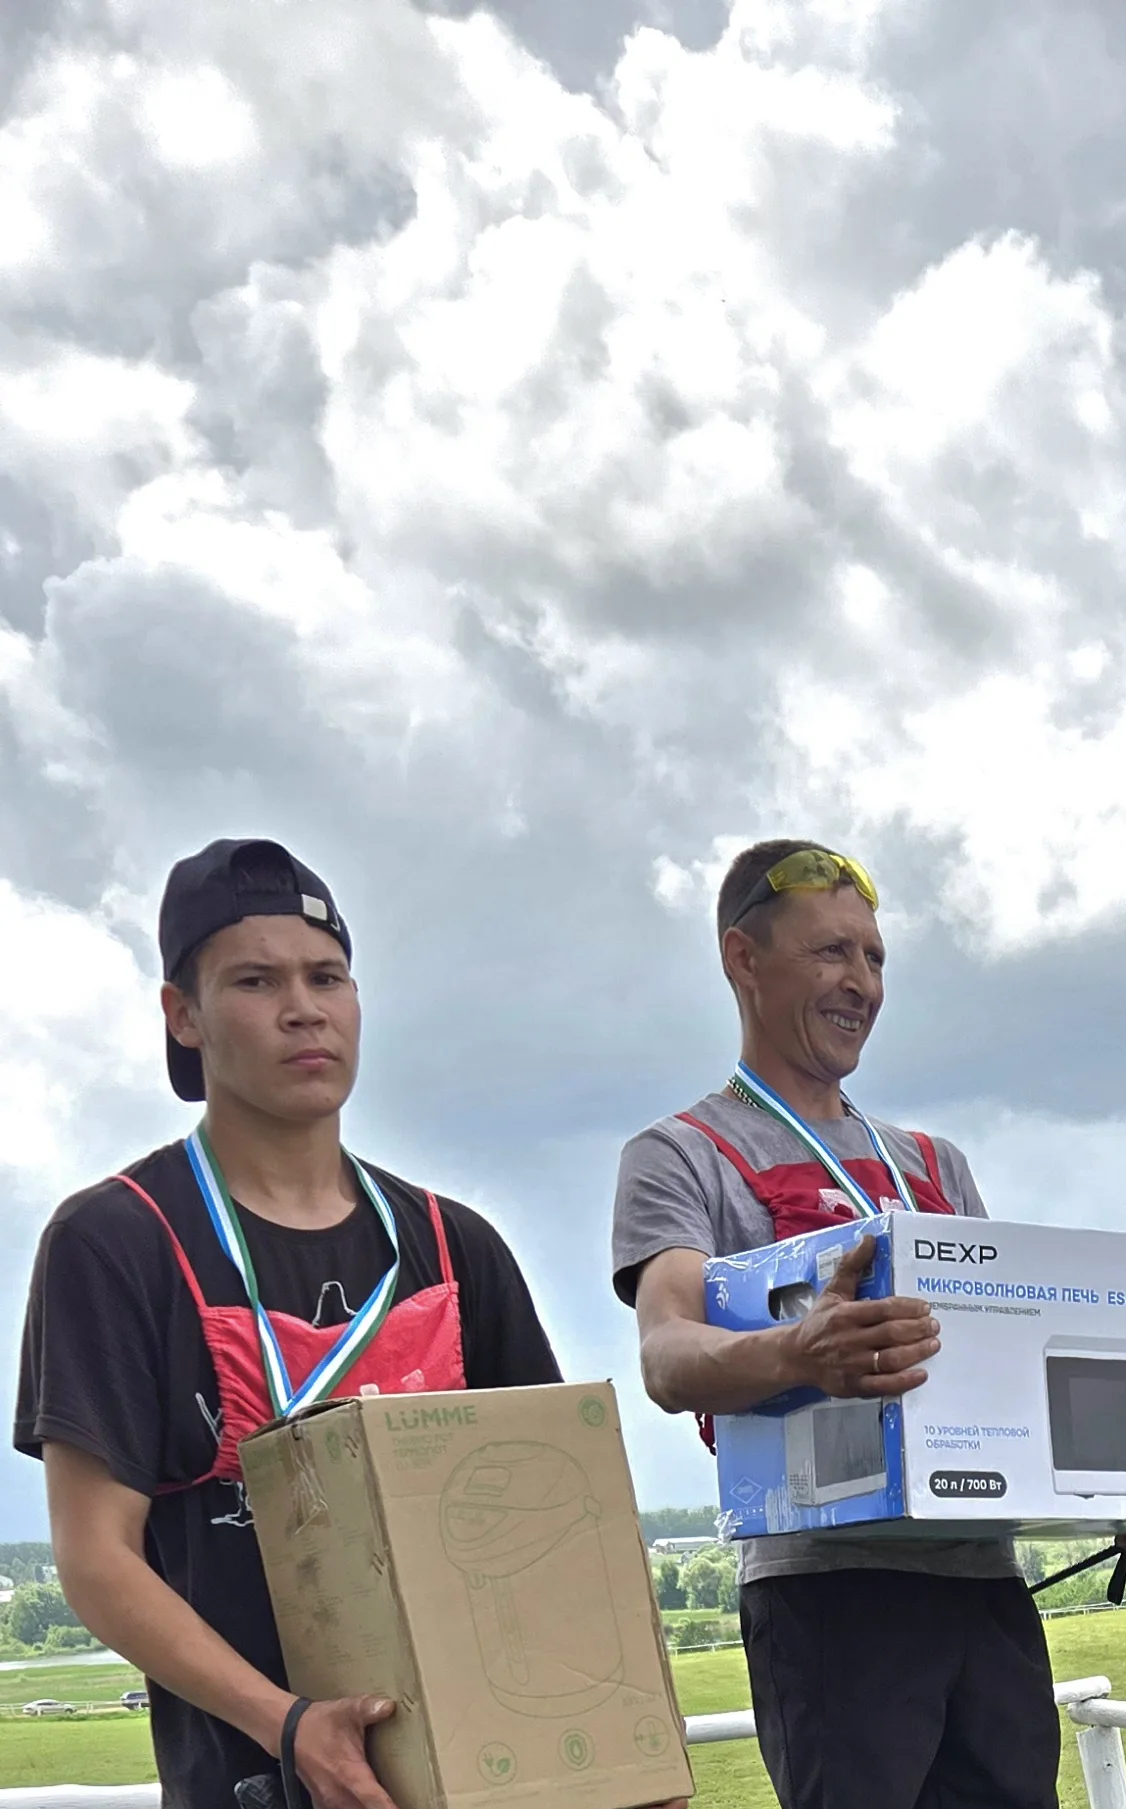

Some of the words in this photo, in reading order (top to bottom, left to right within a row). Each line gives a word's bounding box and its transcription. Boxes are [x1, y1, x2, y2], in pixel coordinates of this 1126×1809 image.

[914, 1239, 998, 1264] DEXP
[917, 1277, 1057, 1301] МИКРОВОЛНОВАЯ
[1062, 1288, 1099, 1304] ПЕЧЬ
[924, 1425, 935, 1435] 10
[938, 1425, 979, 1436] УРОВНЕЙ
[981, 1427, 1029, 1438] ТЕПЛОВОЙ
[926, 1439, 980, 1450] ОБРАБОТКИ
[934, 1478, 948, 1490] 20
[950, 1481, 957, 1490] л
[967, 1479, 987, 1490] 700
[989, 1479, 1002, 1490] Вт
